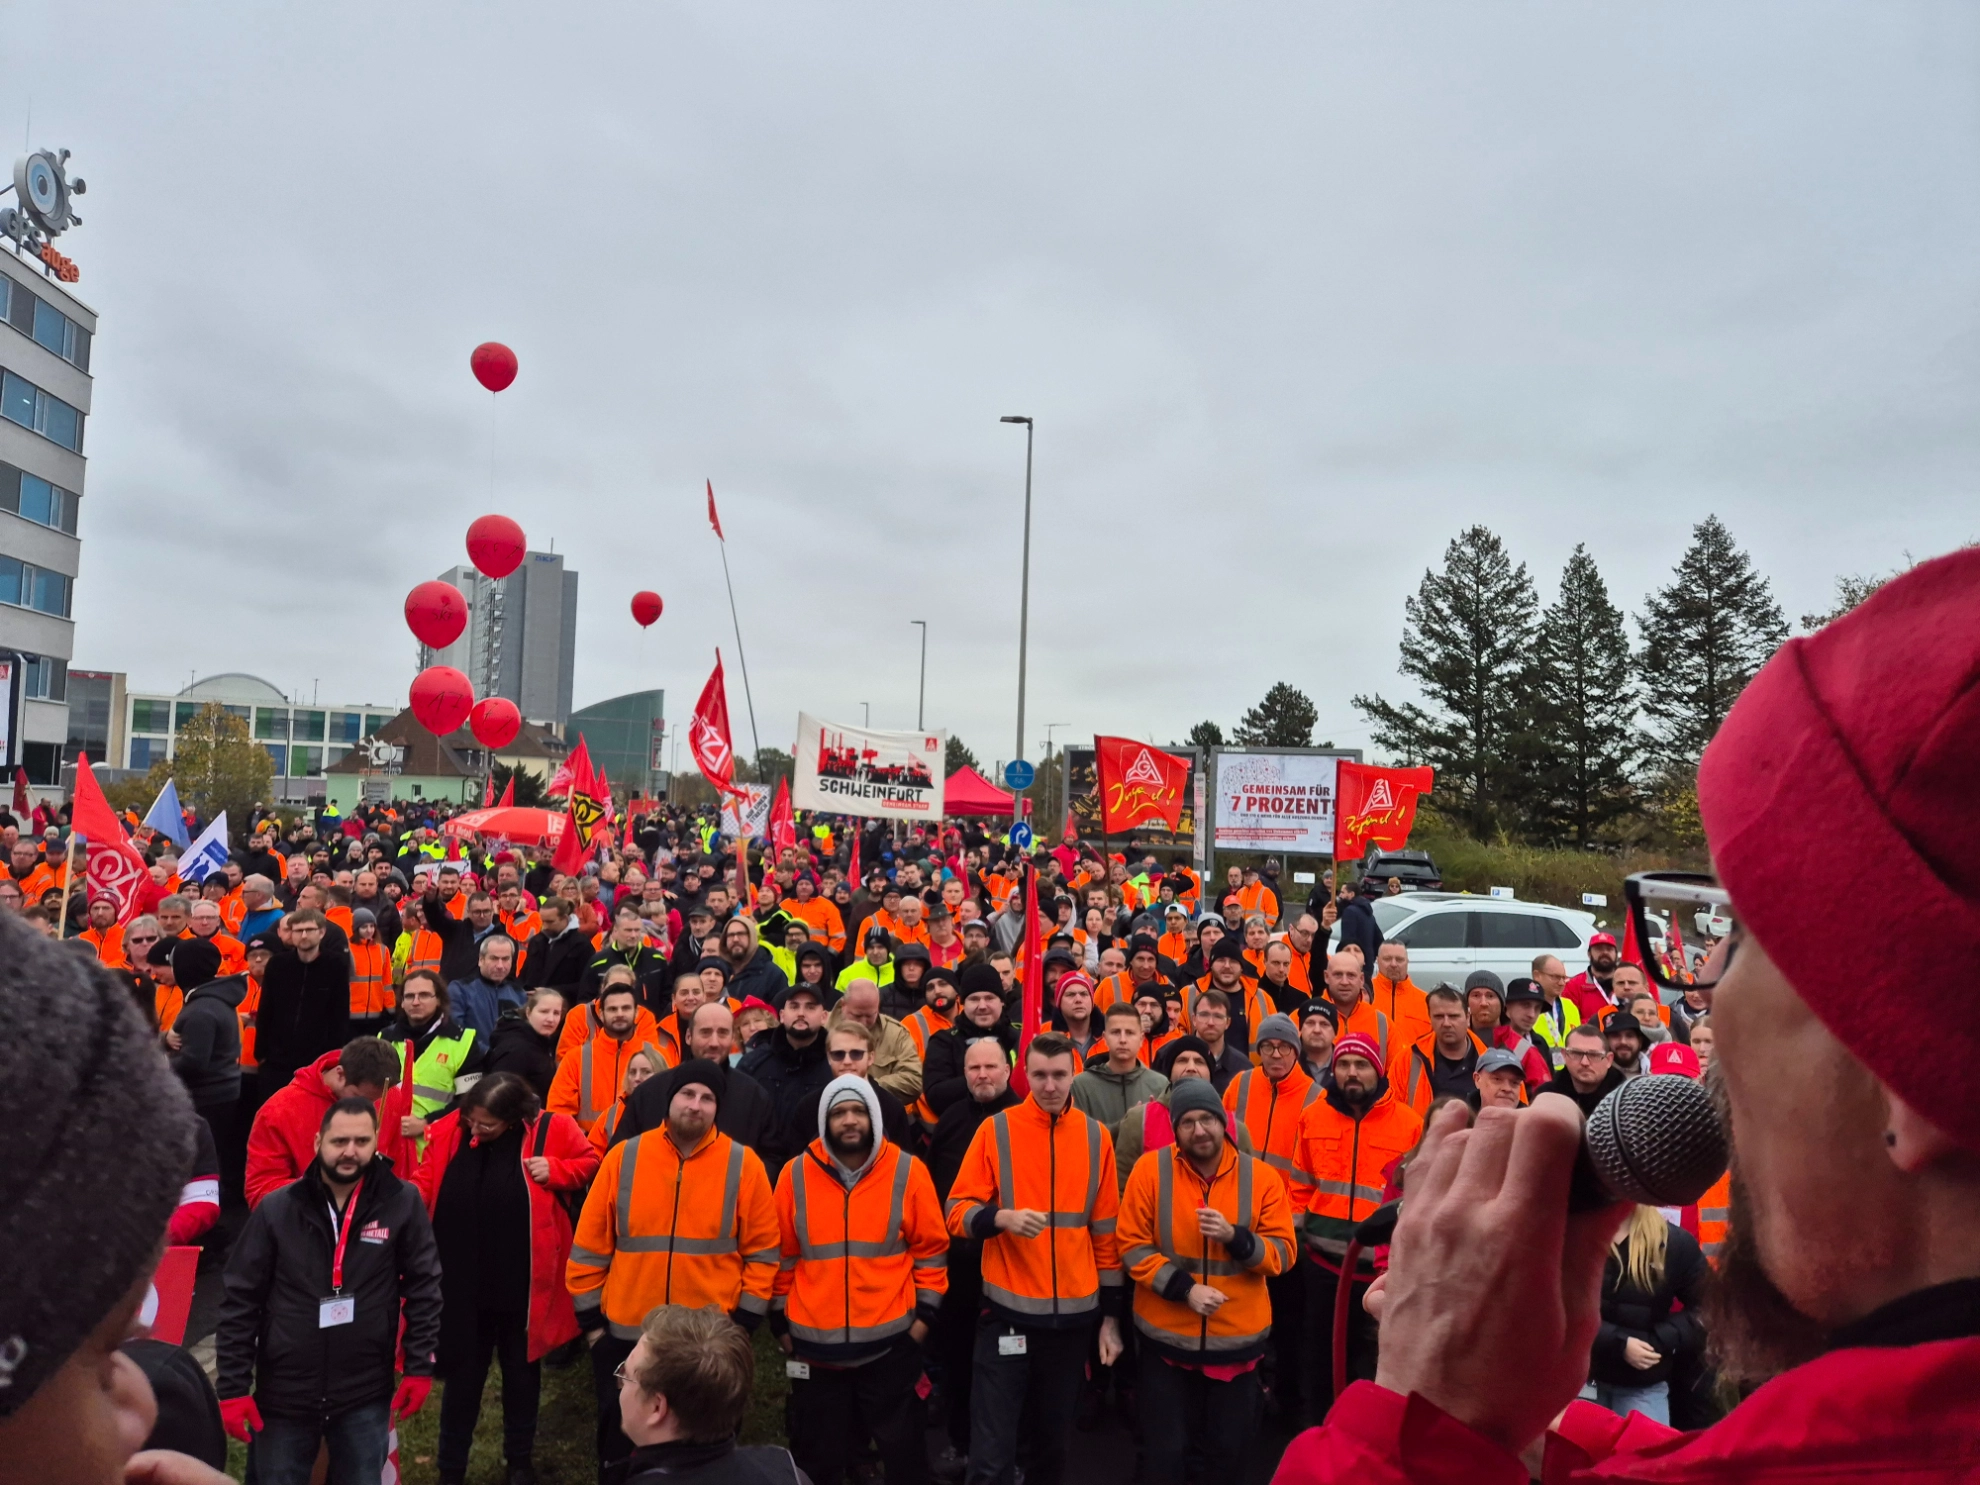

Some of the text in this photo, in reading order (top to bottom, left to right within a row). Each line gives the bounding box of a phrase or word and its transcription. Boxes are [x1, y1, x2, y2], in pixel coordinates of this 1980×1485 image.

[819, 778, 924, 803] SCHWEINFURT
[1242, 784, 1330, 796] GEMEINSAM FÜR
[1231, 796, 1241, 811] 7
